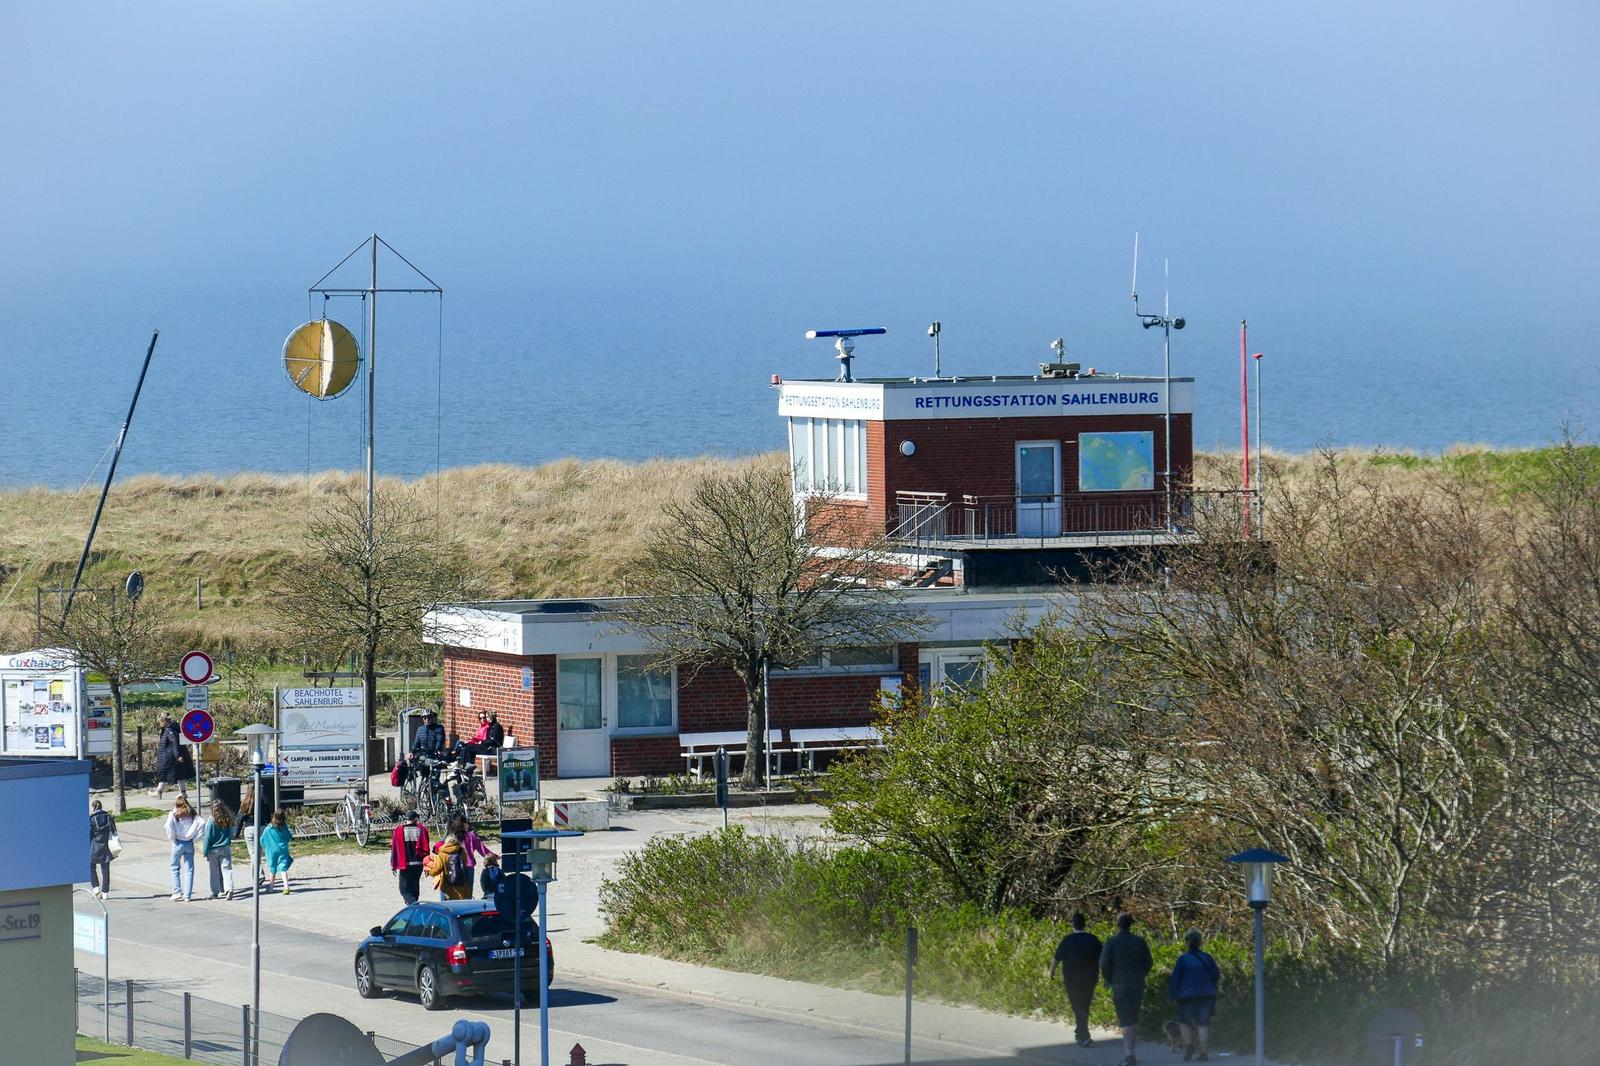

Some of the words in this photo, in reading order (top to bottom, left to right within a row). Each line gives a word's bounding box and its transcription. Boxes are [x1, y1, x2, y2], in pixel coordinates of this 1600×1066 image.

[785, 395, 840, 408] RETTUNGSSTATION
[841, 397, 881, 410] SAHLENBURG
[915, 394, 1056, 408] RETTUNGSSTATION
[1061, 392, 1159, 405] SAHLENBURG
[9, 657, 65, 668] Cuxhaven
[294, 689, 343, 697] BEACHHOTEL
[294, 697, 343, 706] SAHLENBURG
